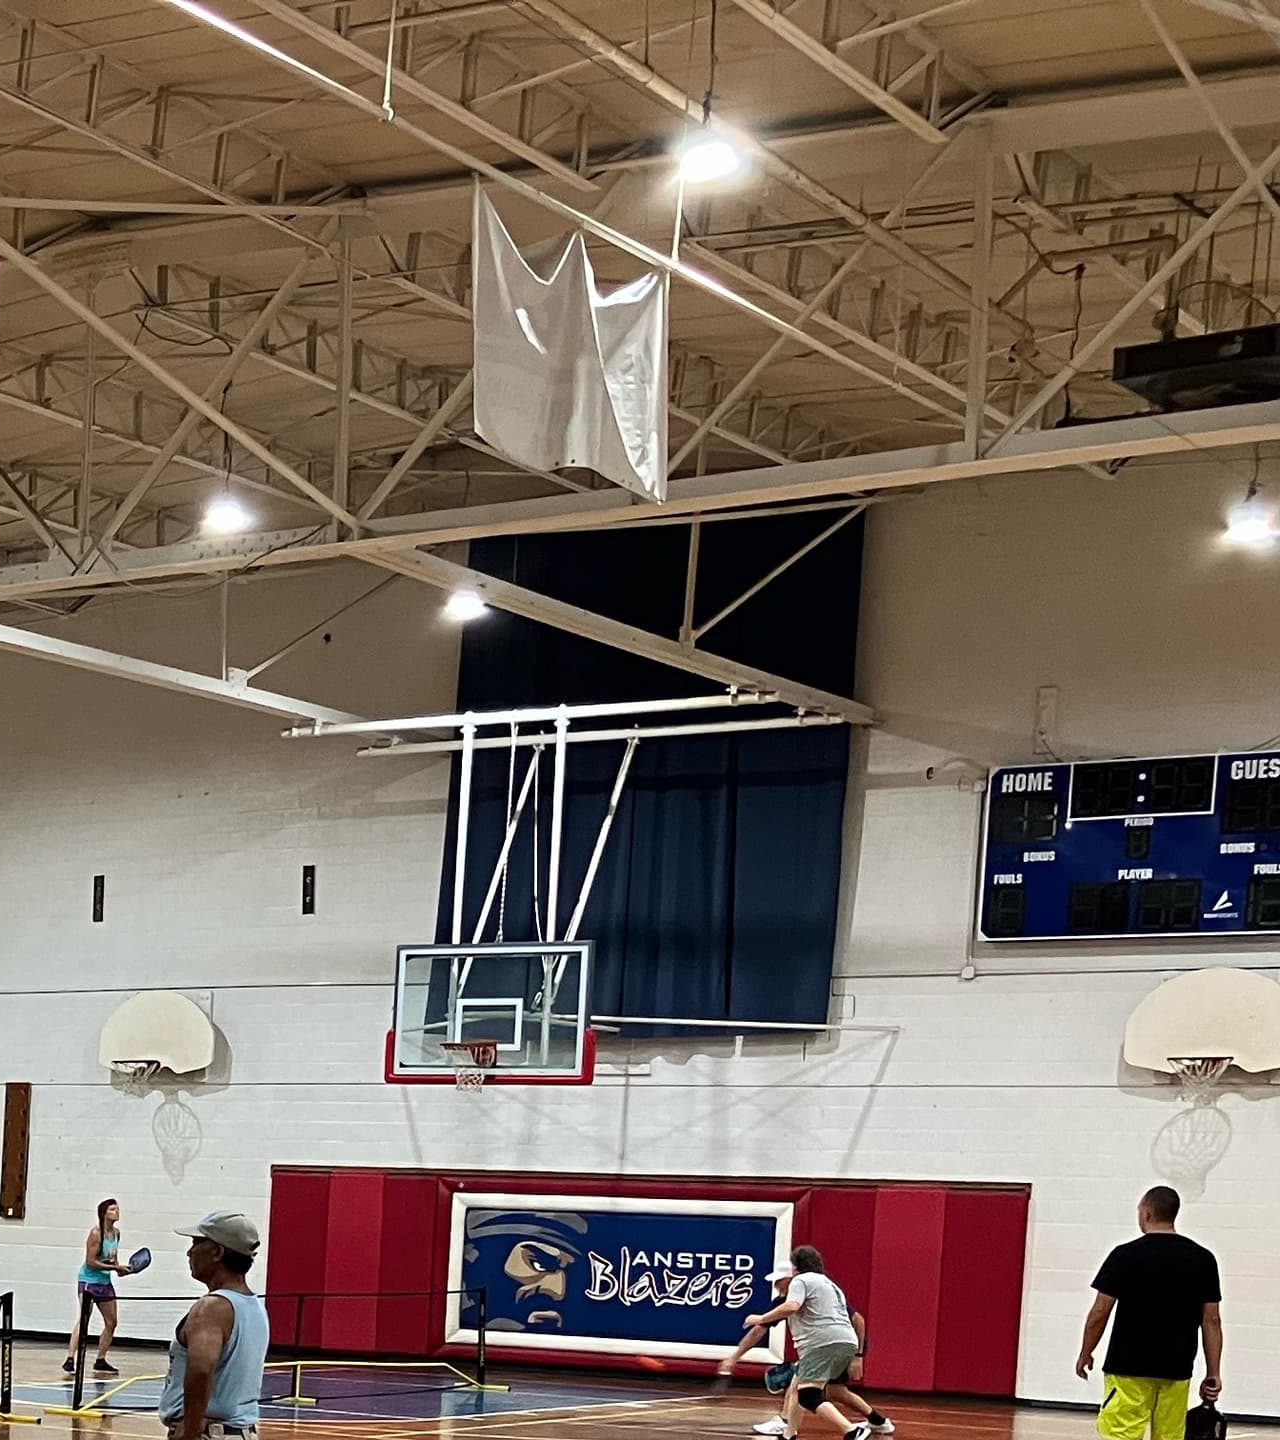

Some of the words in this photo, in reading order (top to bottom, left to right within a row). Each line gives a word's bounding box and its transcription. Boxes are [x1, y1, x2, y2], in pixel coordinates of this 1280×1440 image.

[1001, 771, 1054, 793] HOME
[1117, 868, 1153, 881] PLAYER
[1253, 863, 1280, 875] FOUL
[993, 873, 1023, 885] FOULS
[632, 1251, 754, 1271] ANSTED
[585, 1246, 753, 1308] Blazers
